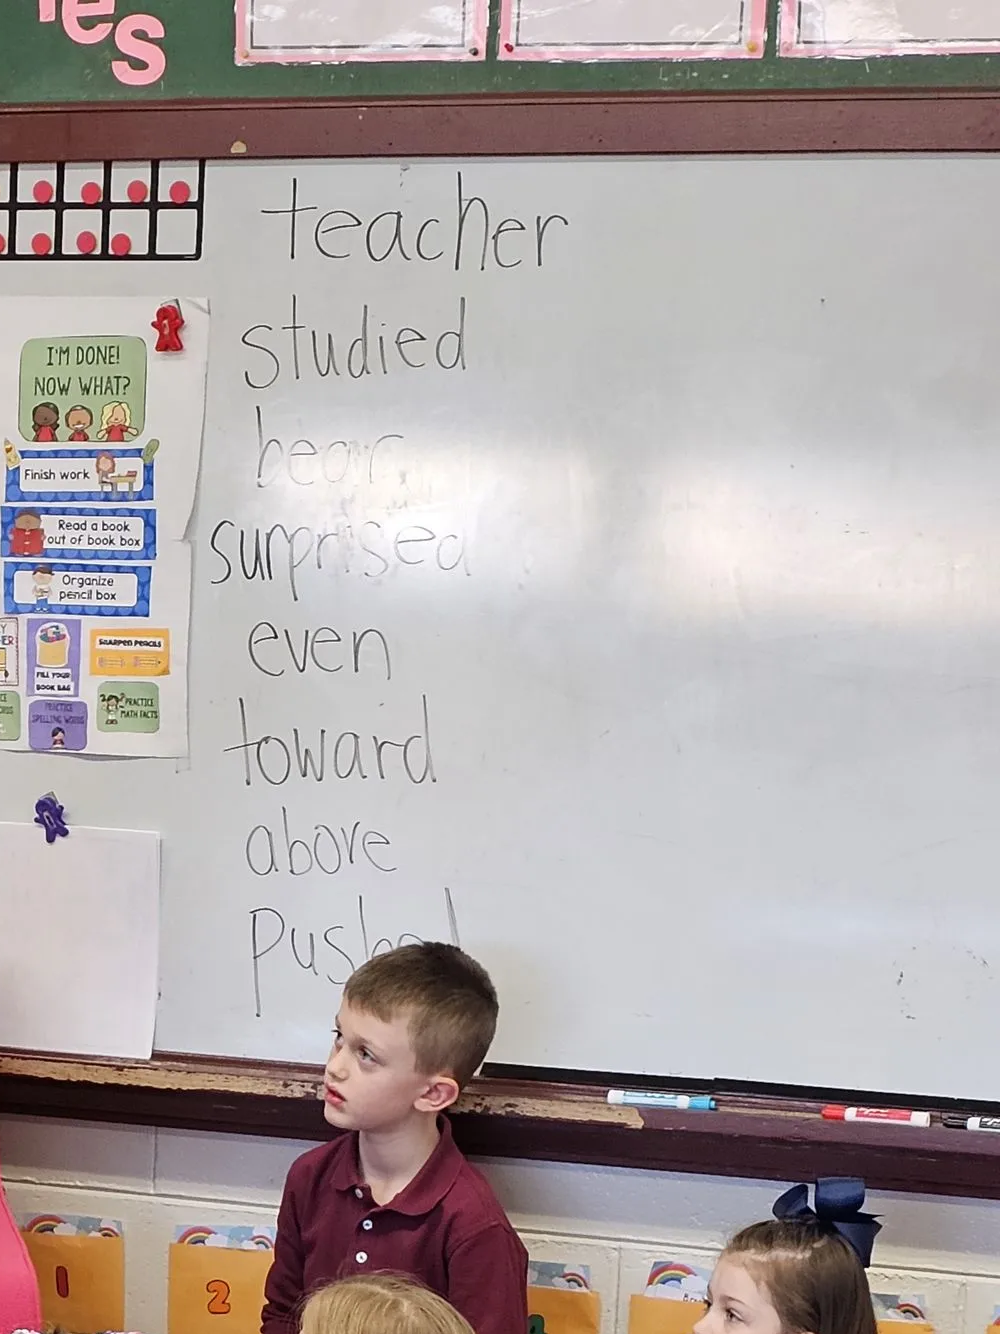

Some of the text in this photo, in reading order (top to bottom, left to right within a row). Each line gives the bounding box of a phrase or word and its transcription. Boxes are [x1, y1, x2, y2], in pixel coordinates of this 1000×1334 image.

[39, 0, 166, 86] es
[261, 171, 569, 271] teacher
[241, 294, 466, 389] studied
[46, 345, 120, 366] I'M DONE!
[33, 375, 131, 396] NOW WHAT?
[255, 405, 404, 488] bear
[24, 469, 90, 480] Finish work
[58, 520, 130, 532] Read a book
[47, 534, 141, 547] out of book box
[210, 519, 471, 602] surprised
[62, 574, 114, 588] Organize
[59, 589, 117, 601] pencil box
[248, 621, 391, 681] even
[36, 671, 50, 679] FILL
[36, 683, 56, 691] BOOK
[124, 697, 155, 706] PRACTICE
[120, 710, 159, 719] MATH FACTS
[223, 694, 437, 787] toward
[246, 807, 397, 876] above
[206, 1279, 232, 1315] 2
